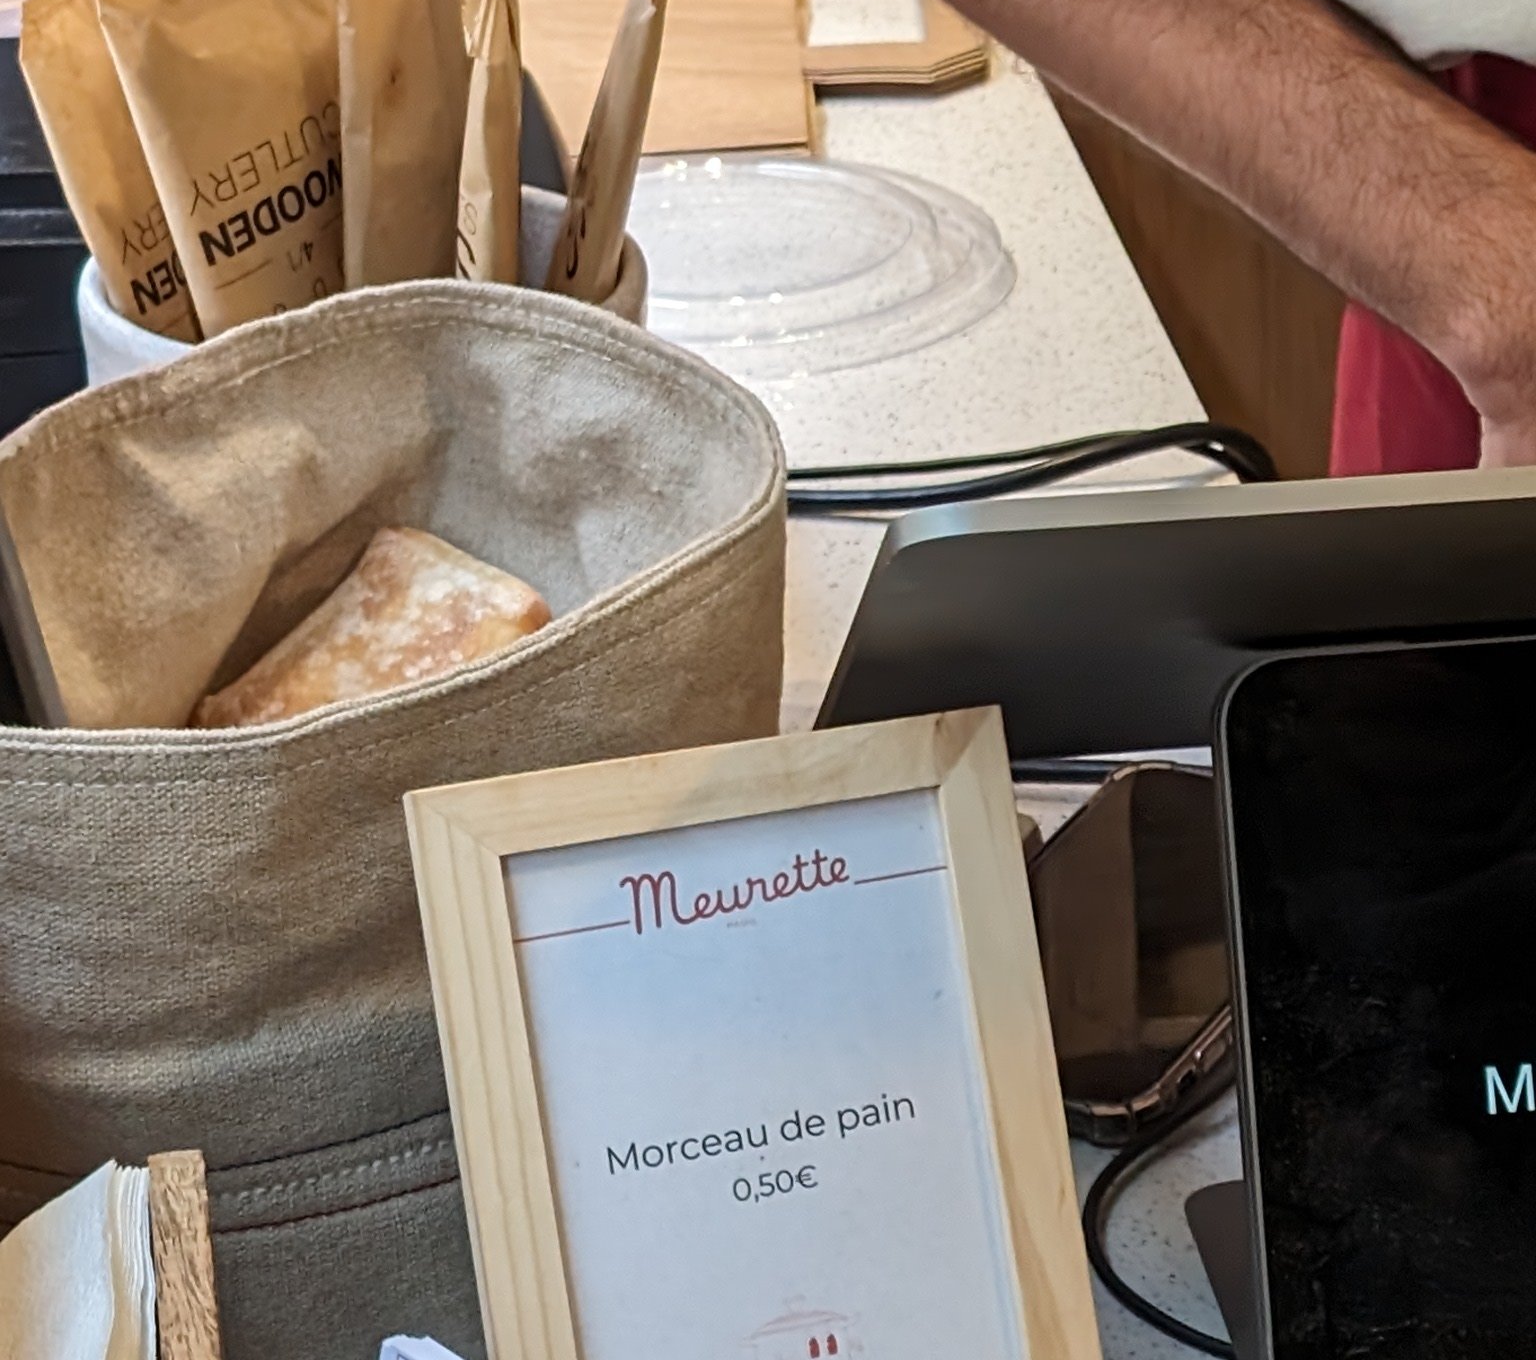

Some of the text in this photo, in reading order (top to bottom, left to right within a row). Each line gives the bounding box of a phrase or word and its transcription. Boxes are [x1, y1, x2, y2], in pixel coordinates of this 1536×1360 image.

[619, 848, 850, 936] Meurette
[605, 1092, 916, 1176] Morceau de pain
[732, 1164, 819, 1204] 0,50€
